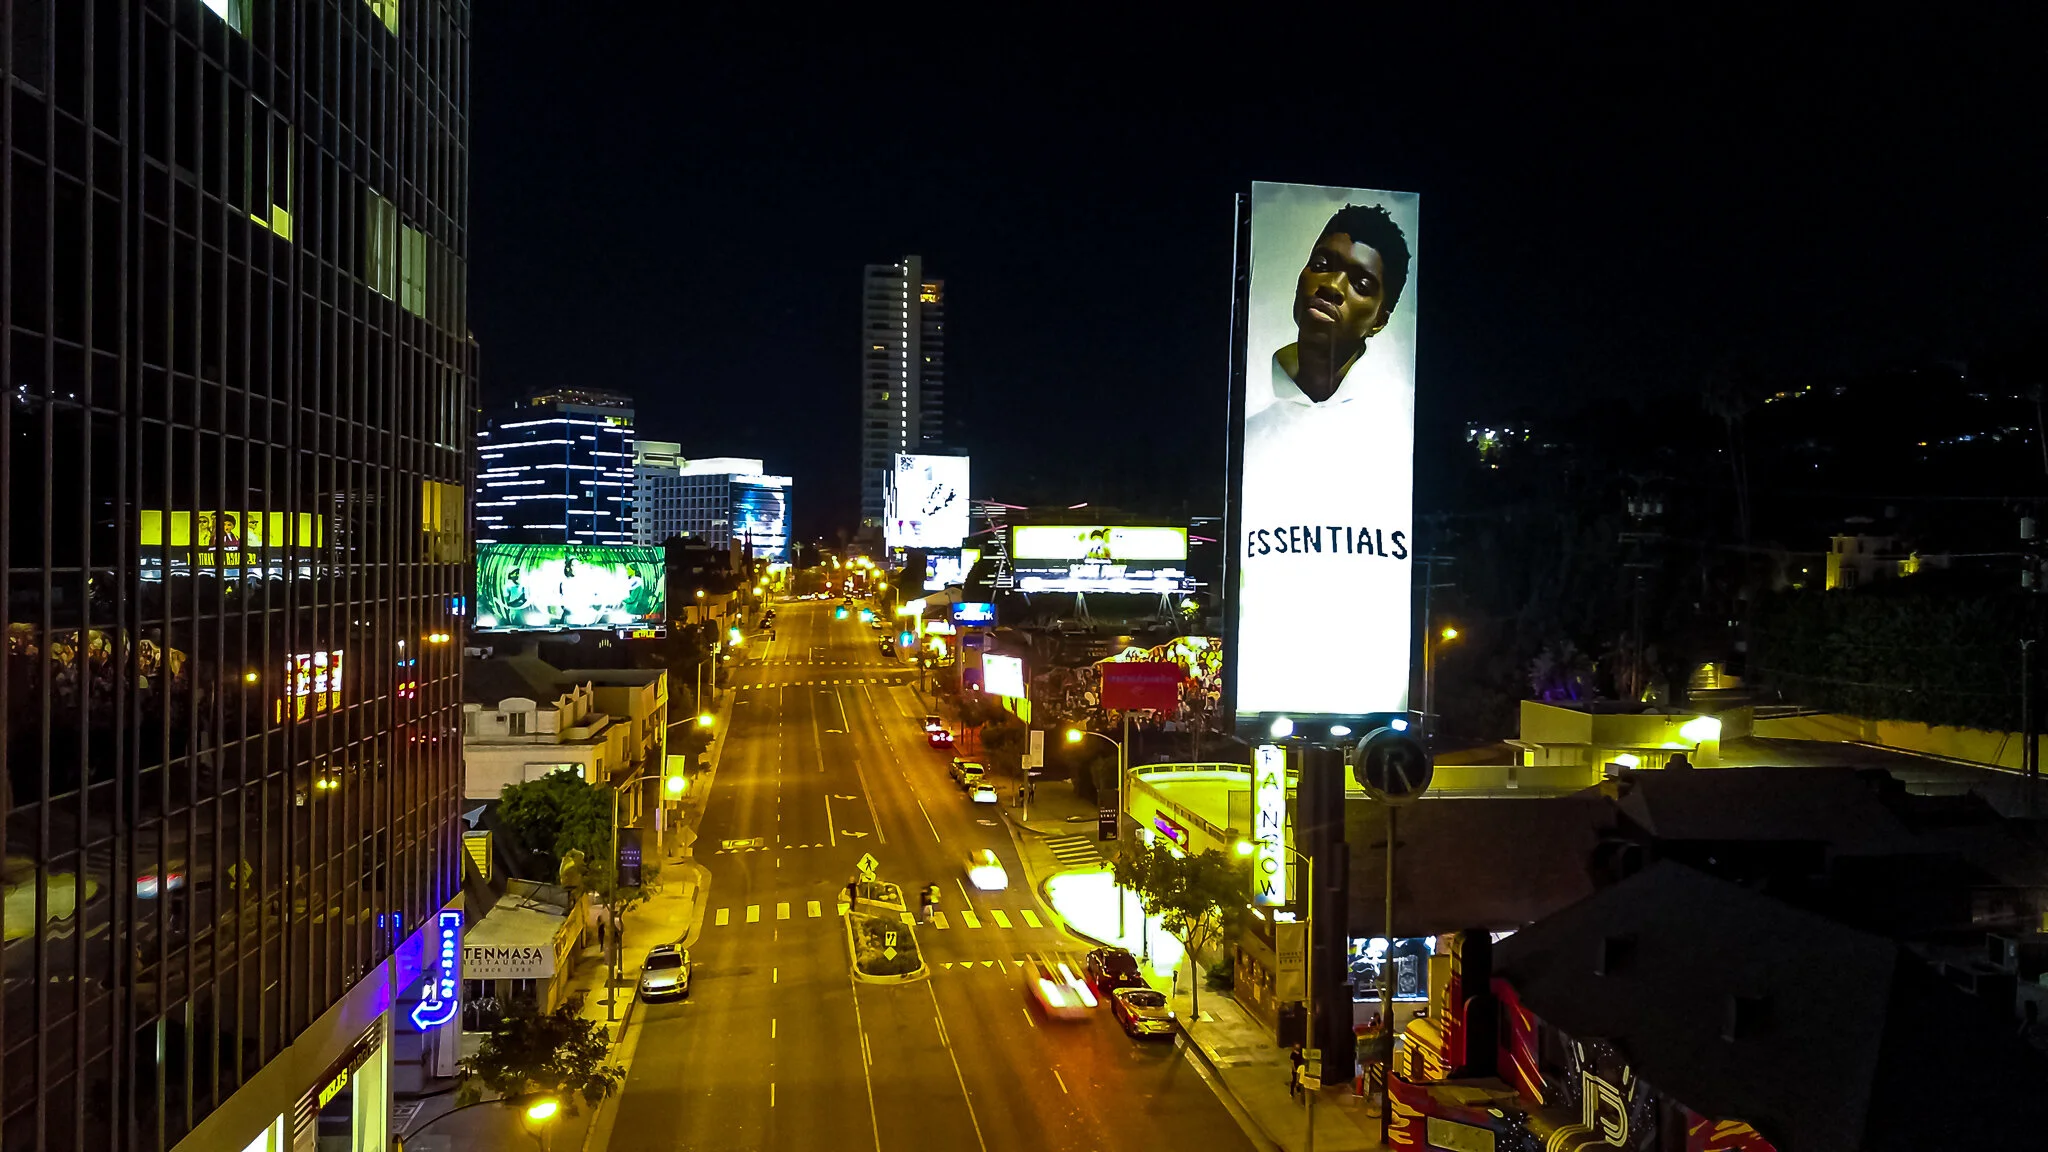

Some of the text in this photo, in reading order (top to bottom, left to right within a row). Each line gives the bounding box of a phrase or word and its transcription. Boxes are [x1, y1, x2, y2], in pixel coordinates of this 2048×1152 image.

[1247, 525, 1408, 560] ESSENTIALS
[1260, 749, 1279, 897] ANBOW
[464, 947, 543, 960] TENMASA
[318, 1067, 348, 1109] WELLS
